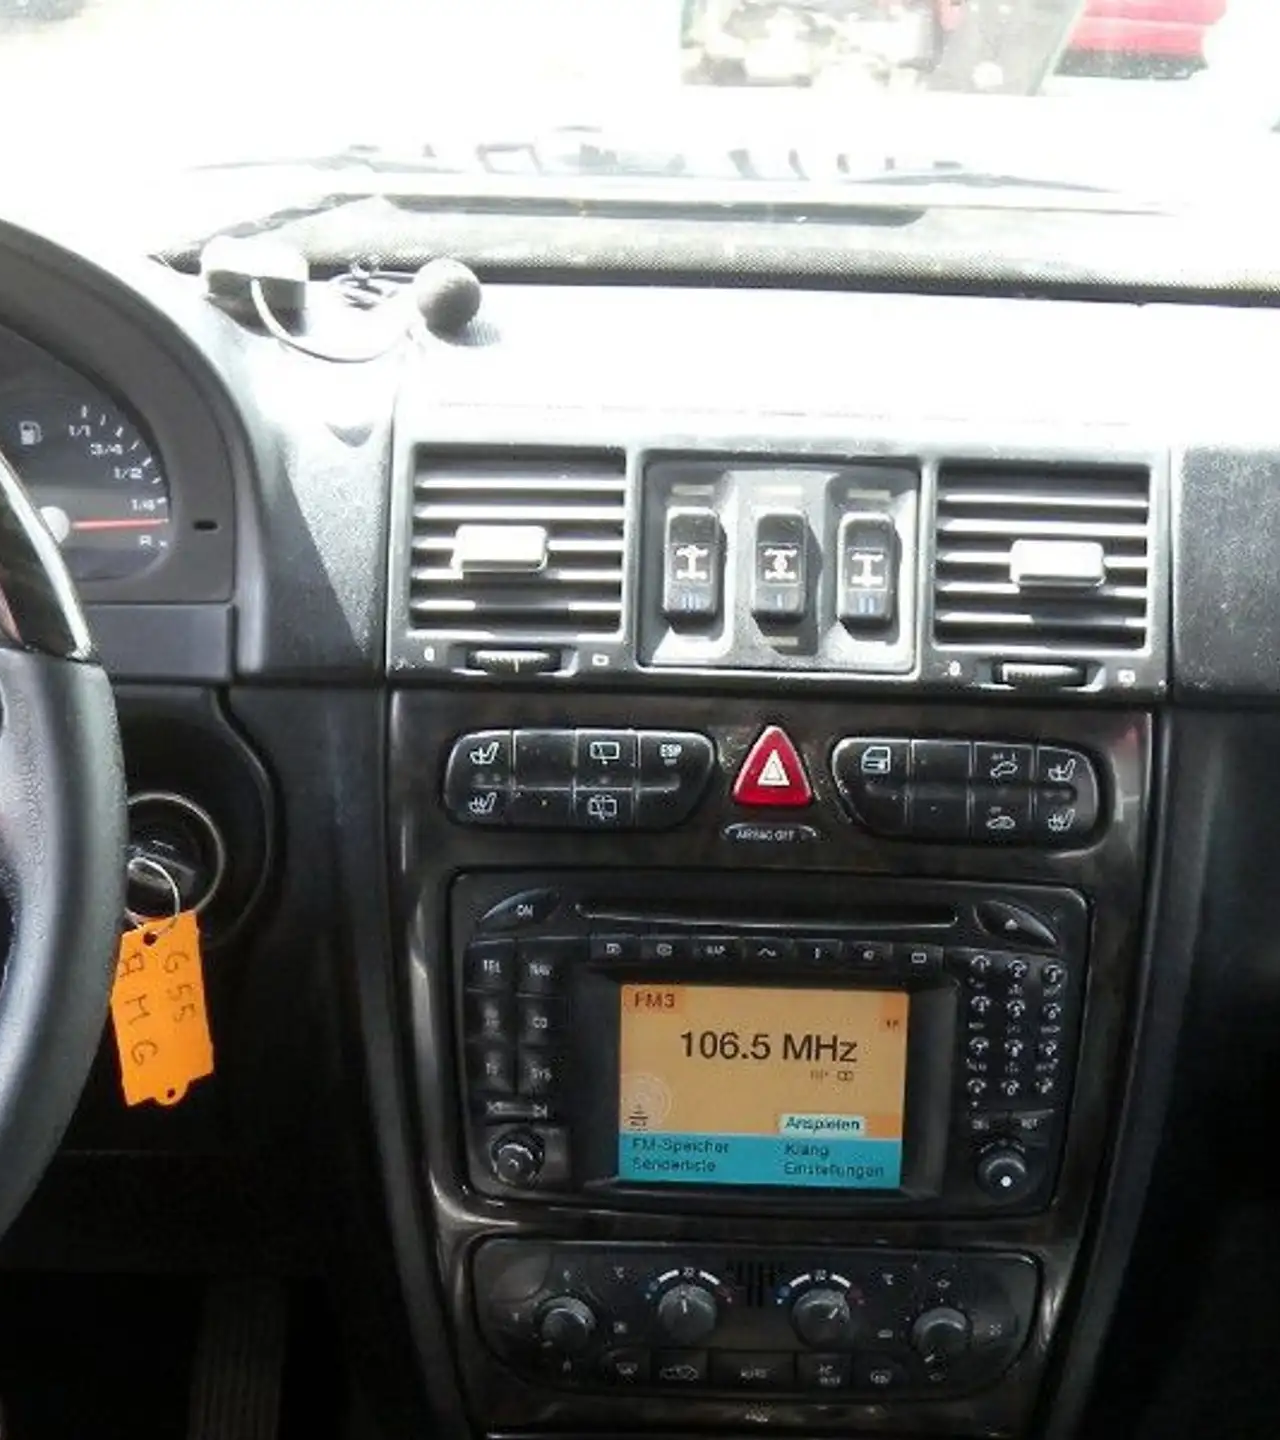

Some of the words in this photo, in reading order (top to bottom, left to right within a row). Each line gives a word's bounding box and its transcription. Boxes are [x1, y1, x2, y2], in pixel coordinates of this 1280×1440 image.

[90, 443, 124, 457] 3/4
[114, 467, 144, 480] 1/2
[130, 499, 156, 512] 1/4
[634, 993, 676, 1009] FM3
[680, 1030, 771, 1060] 106.5
[782, 1034, 858, 1063] MHz
